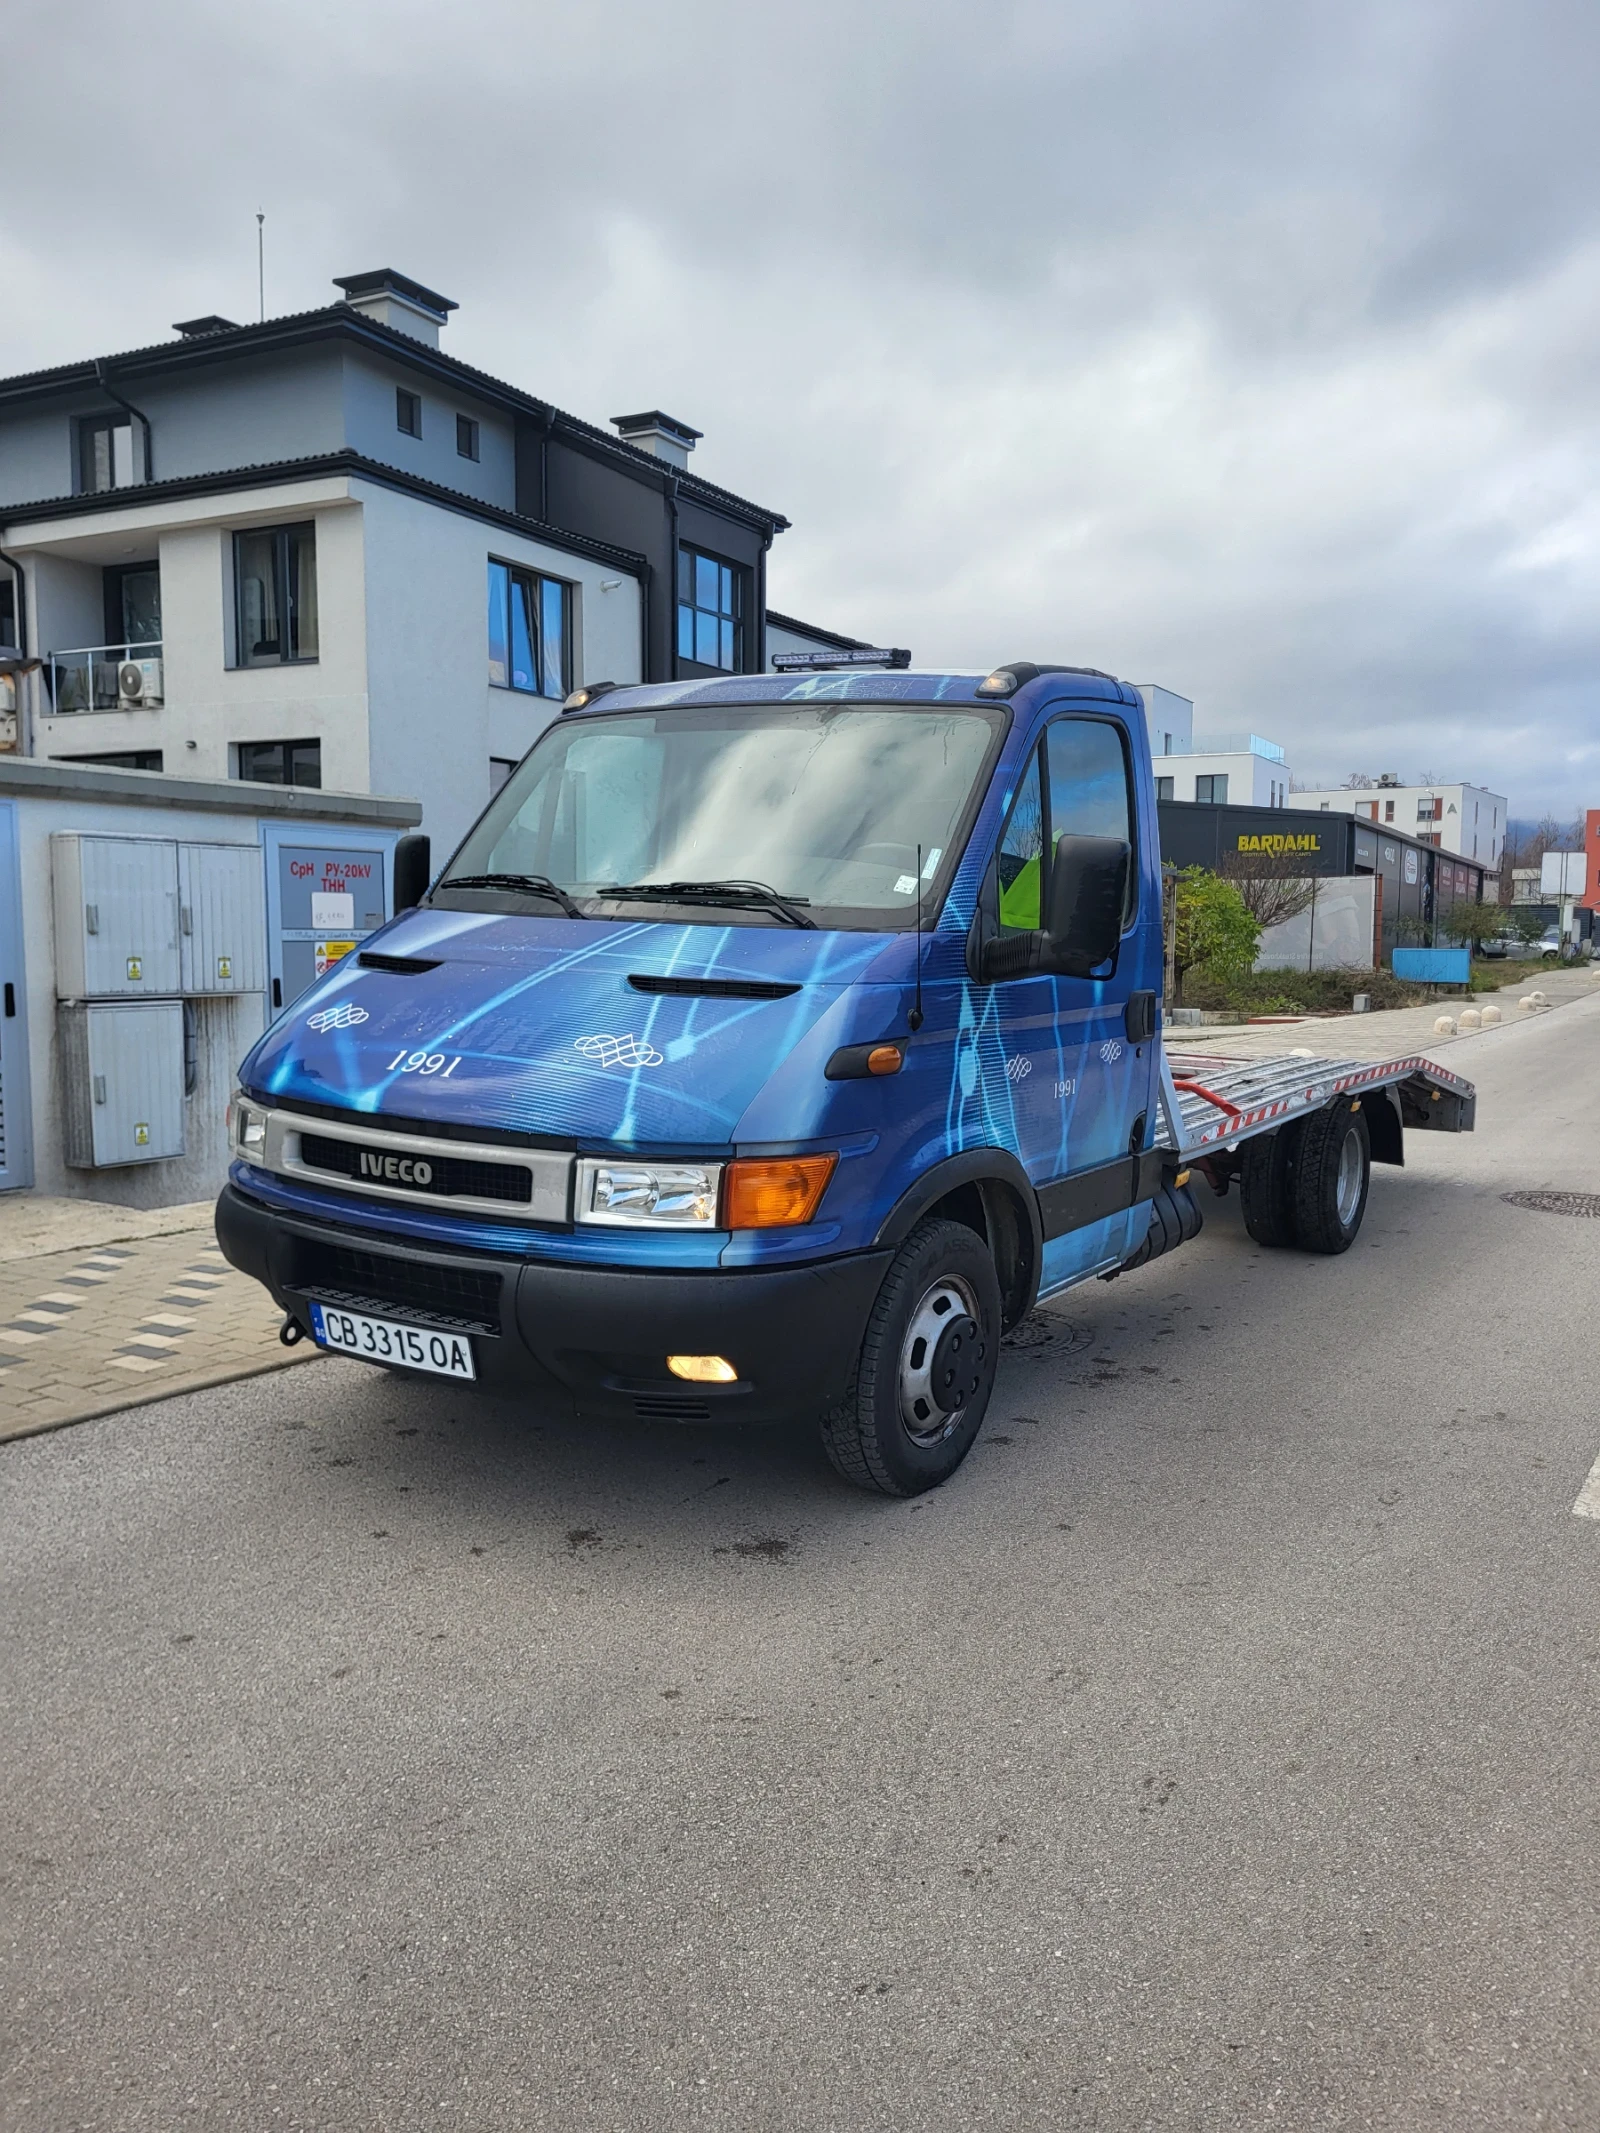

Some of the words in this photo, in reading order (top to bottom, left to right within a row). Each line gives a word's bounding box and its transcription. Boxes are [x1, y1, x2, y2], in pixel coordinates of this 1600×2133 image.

[1238, 834, 1320, 858] BARDAHL
[386, 1050, 462, 1078] 1991
[1054, 1079, 1076, 1099] 1991
[360, 1152, 432, 1184] IVECO
[315, 1327, 326, 1338] BG
